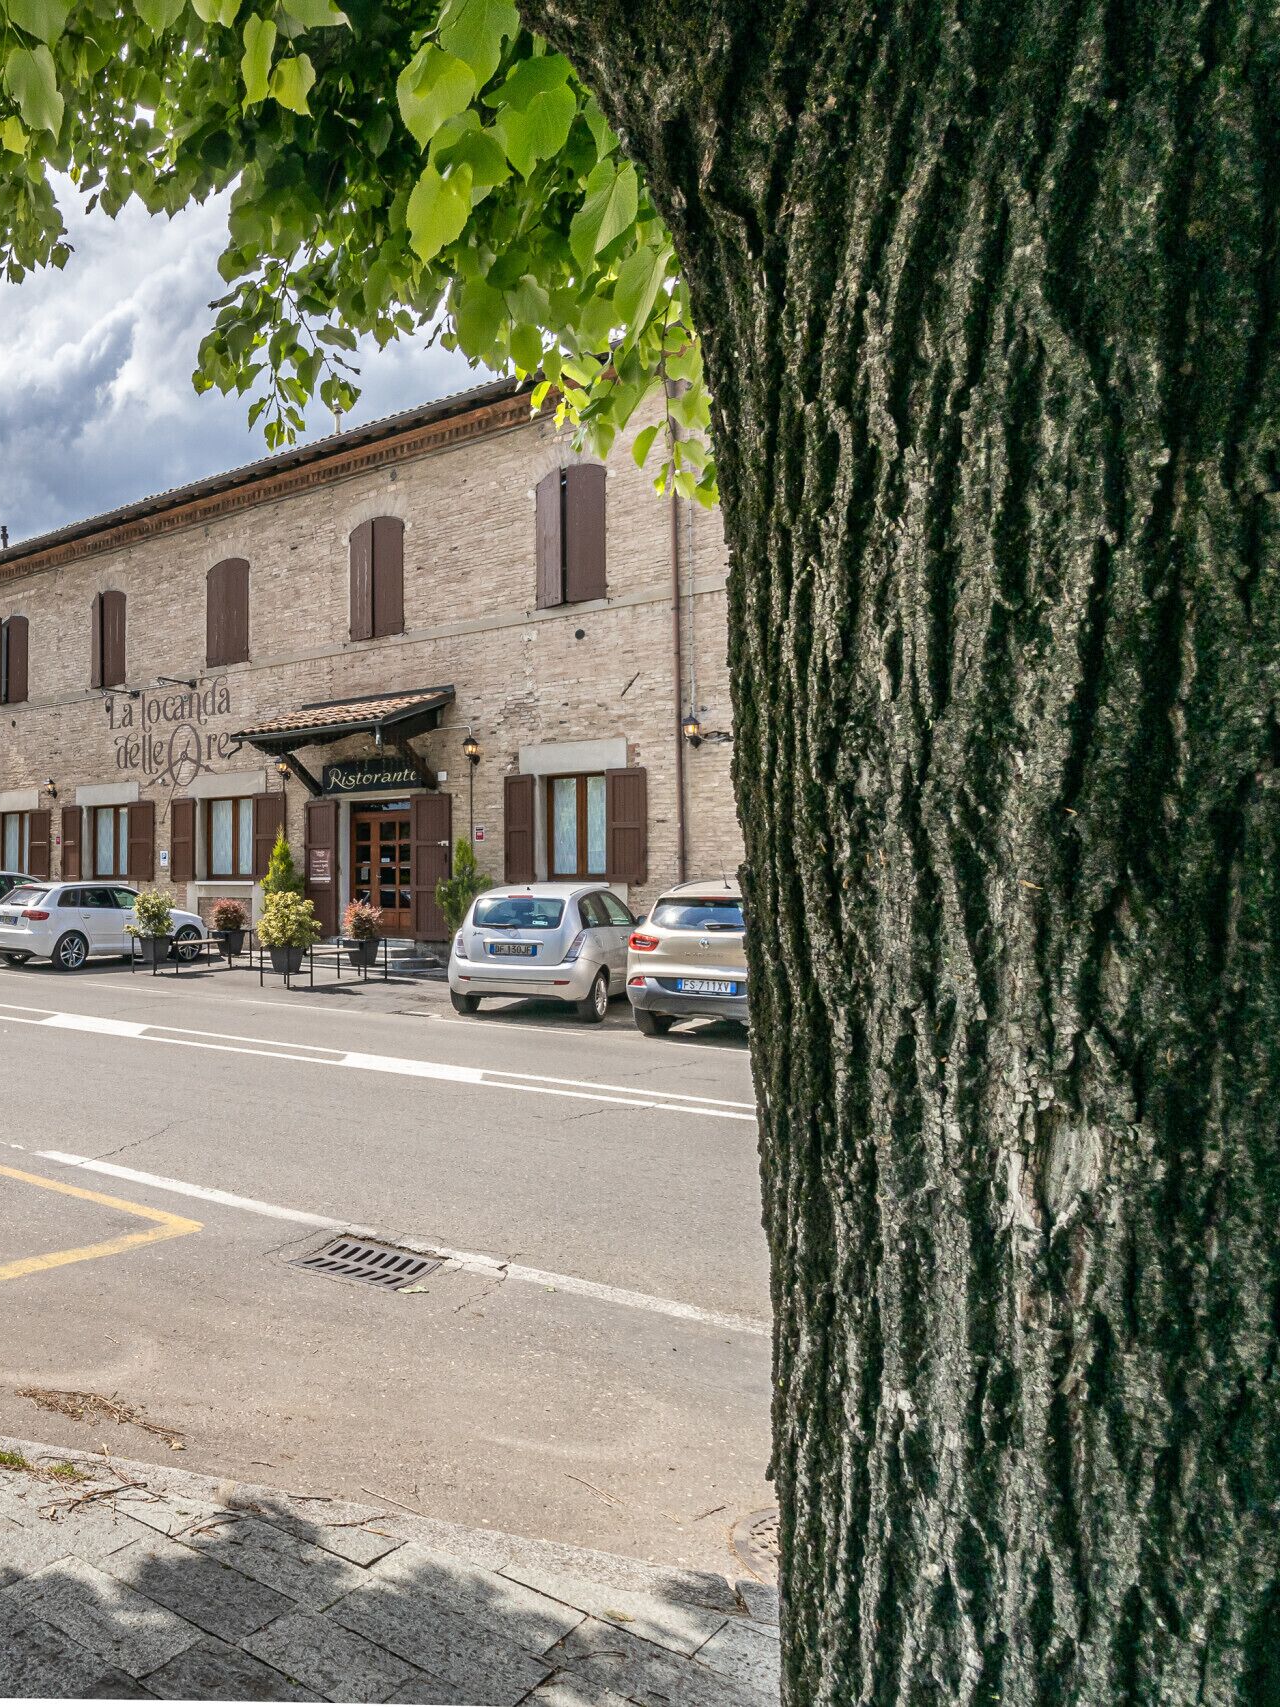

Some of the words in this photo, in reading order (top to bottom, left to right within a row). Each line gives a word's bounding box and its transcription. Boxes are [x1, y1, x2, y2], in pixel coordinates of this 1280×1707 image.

[104, 695, 133, 730] La
[141, 677, 231, 733] locanda
[114, 733, 164, 775] delle
[327, 767, 418, 790] Ristorante
